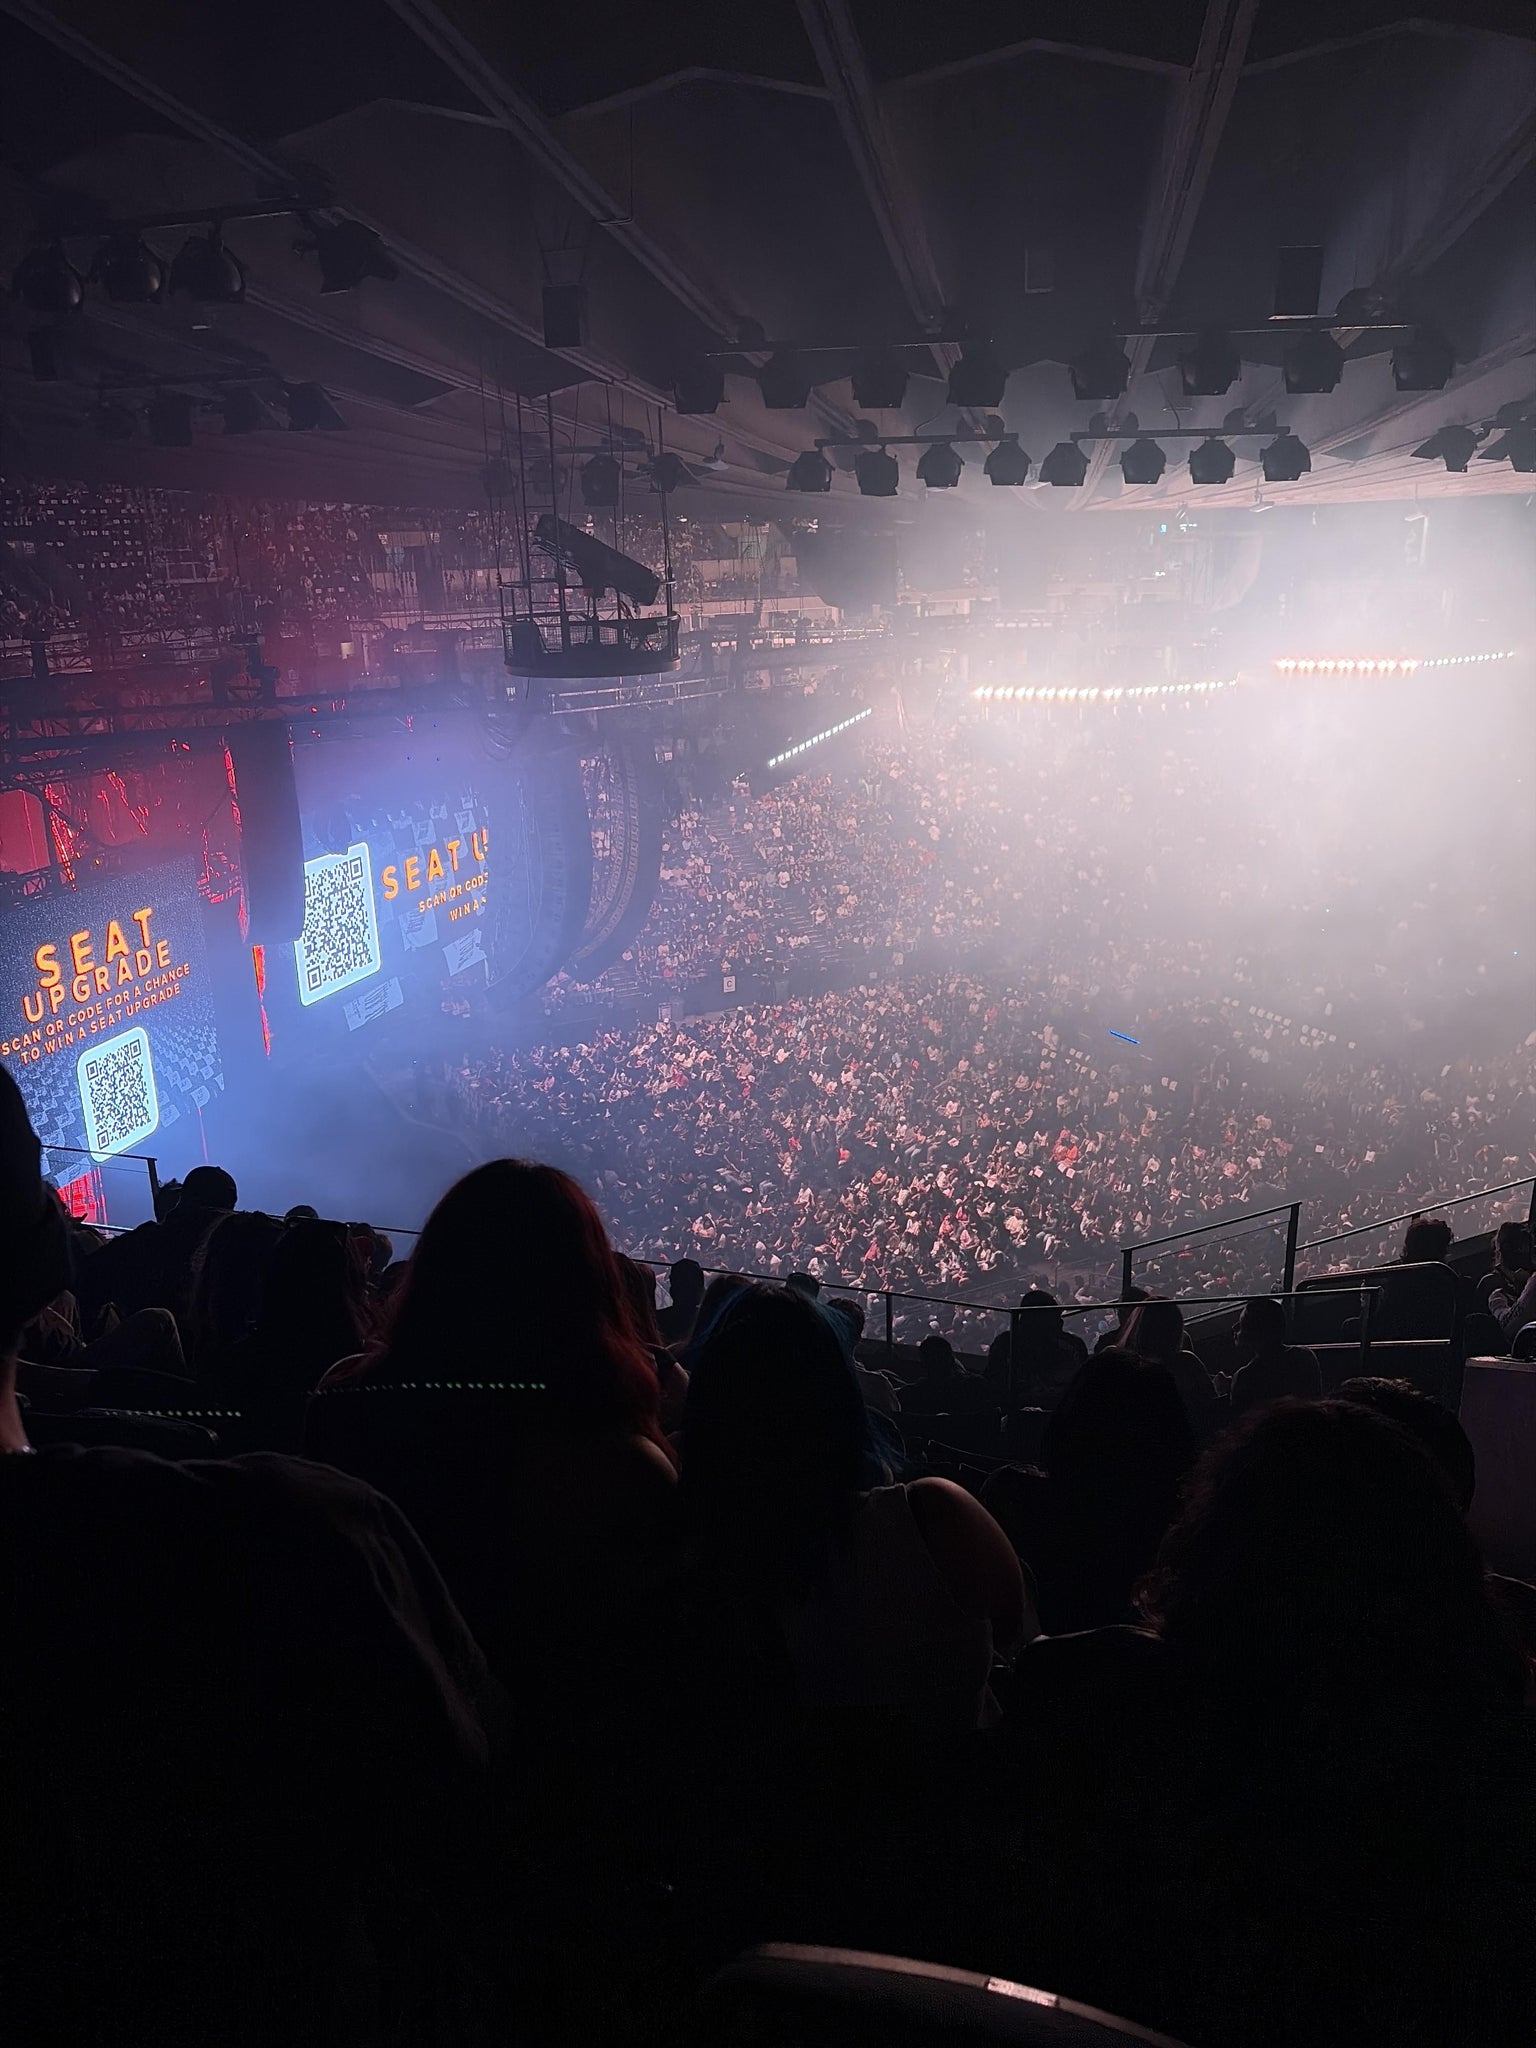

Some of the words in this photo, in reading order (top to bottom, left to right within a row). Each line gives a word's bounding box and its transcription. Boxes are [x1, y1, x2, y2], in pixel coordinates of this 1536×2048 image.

[382, 840, 460, 901] SEAT
[418, 891, 447, 913] SCAN
[449, 903, 471, 922] WIN
[472, 899, 480, 911] A
[23, 940, 172, 1023] UPGRADE
[35, 907, 153, 989] SEAT
[0, 1029, 41, 1056] SCAN
[45, 1020, 65, 1037] QR
[68, 1002, 104, 1026] CODE
[105, 990, 131, 1011] FOR
[133, 985, 142, 998] A
[144, 963, 191, 992] CHANCE
[21, 1046, 41, 1065] TO
[44, 1032, 74, 1055] WIN
[77, 1026, 88, 1040] A
[90, 1010, 122, 1034] SEAT
[126, 983, 181, 1017] UPGRADE
